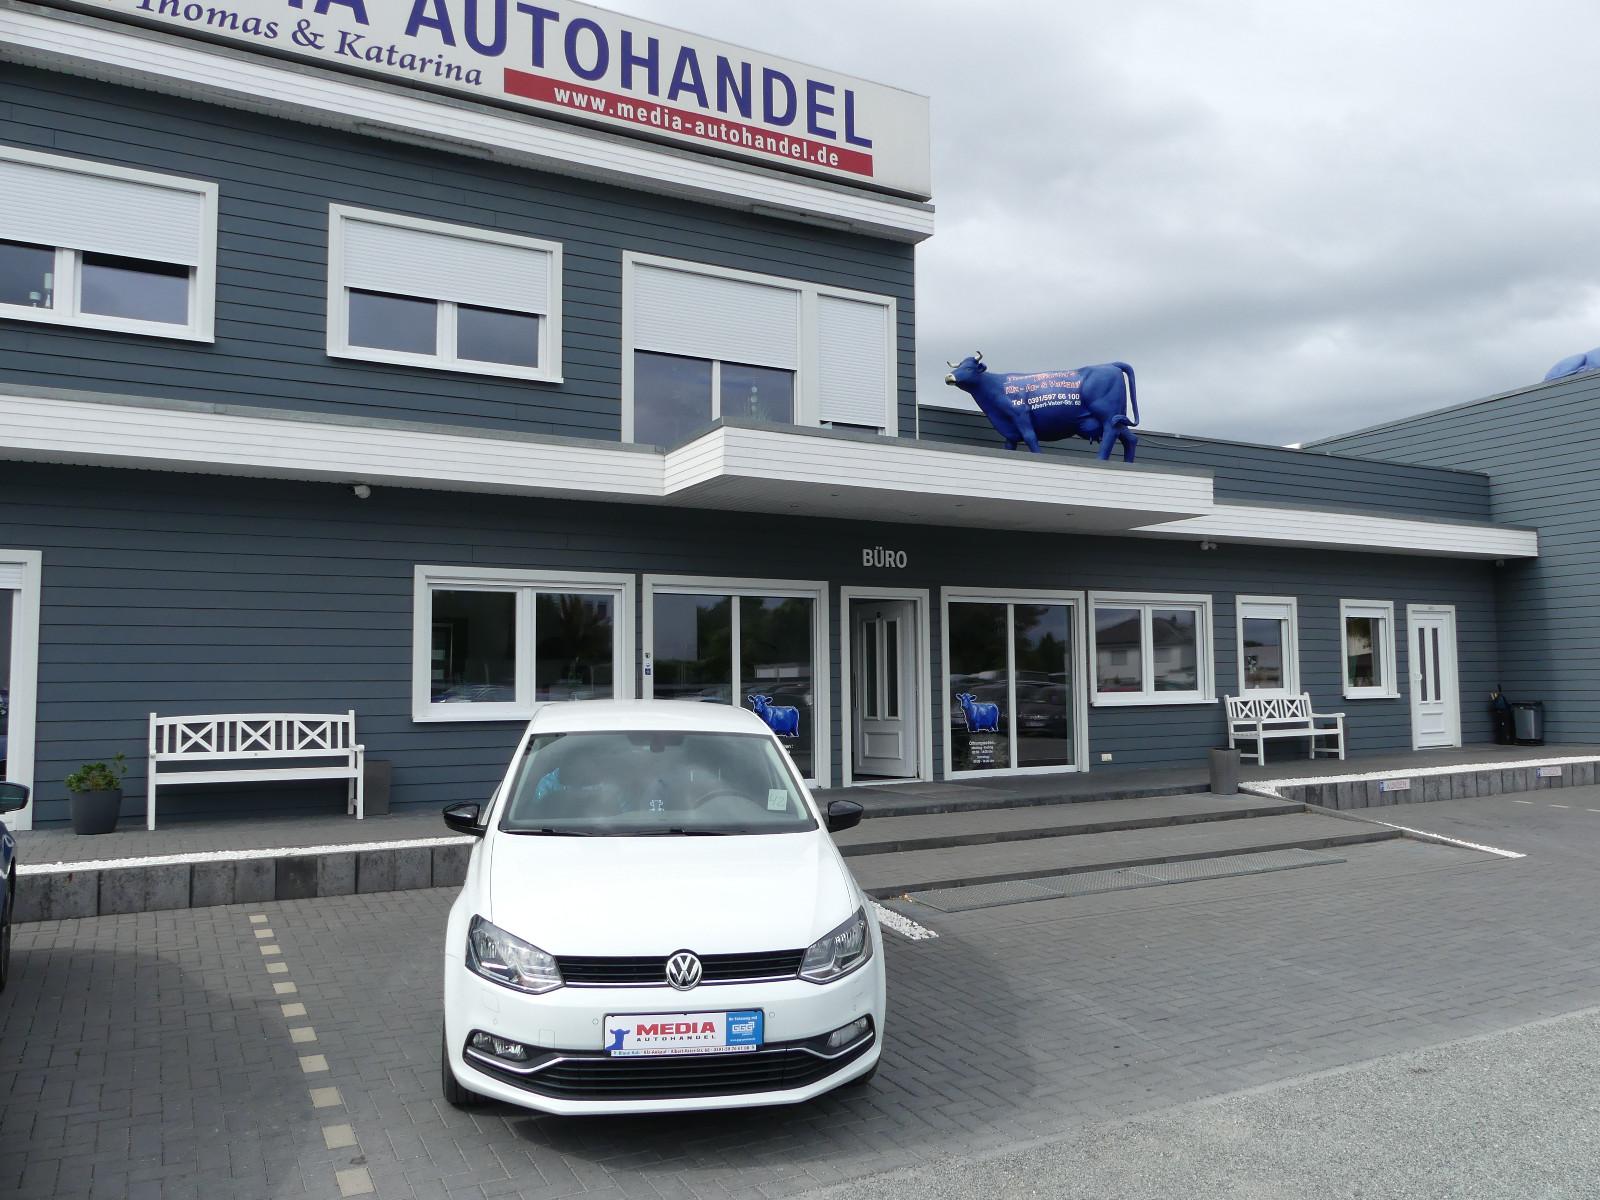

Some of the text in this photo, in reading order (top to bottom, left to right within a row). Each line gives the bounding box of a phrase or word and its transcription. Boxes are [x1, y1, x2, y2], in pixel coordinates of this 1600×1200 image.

[291, 18, 325, 51] &
[334, 30, 482, 87] Katarina
[404, 0, 873, 150] AUTOHANDEL
[553, 86, 839, 168] www.media-autohandel.de
[863, 546, 908, 568] BÜRO
[636, 1021, 716, 1036] MEDIA
